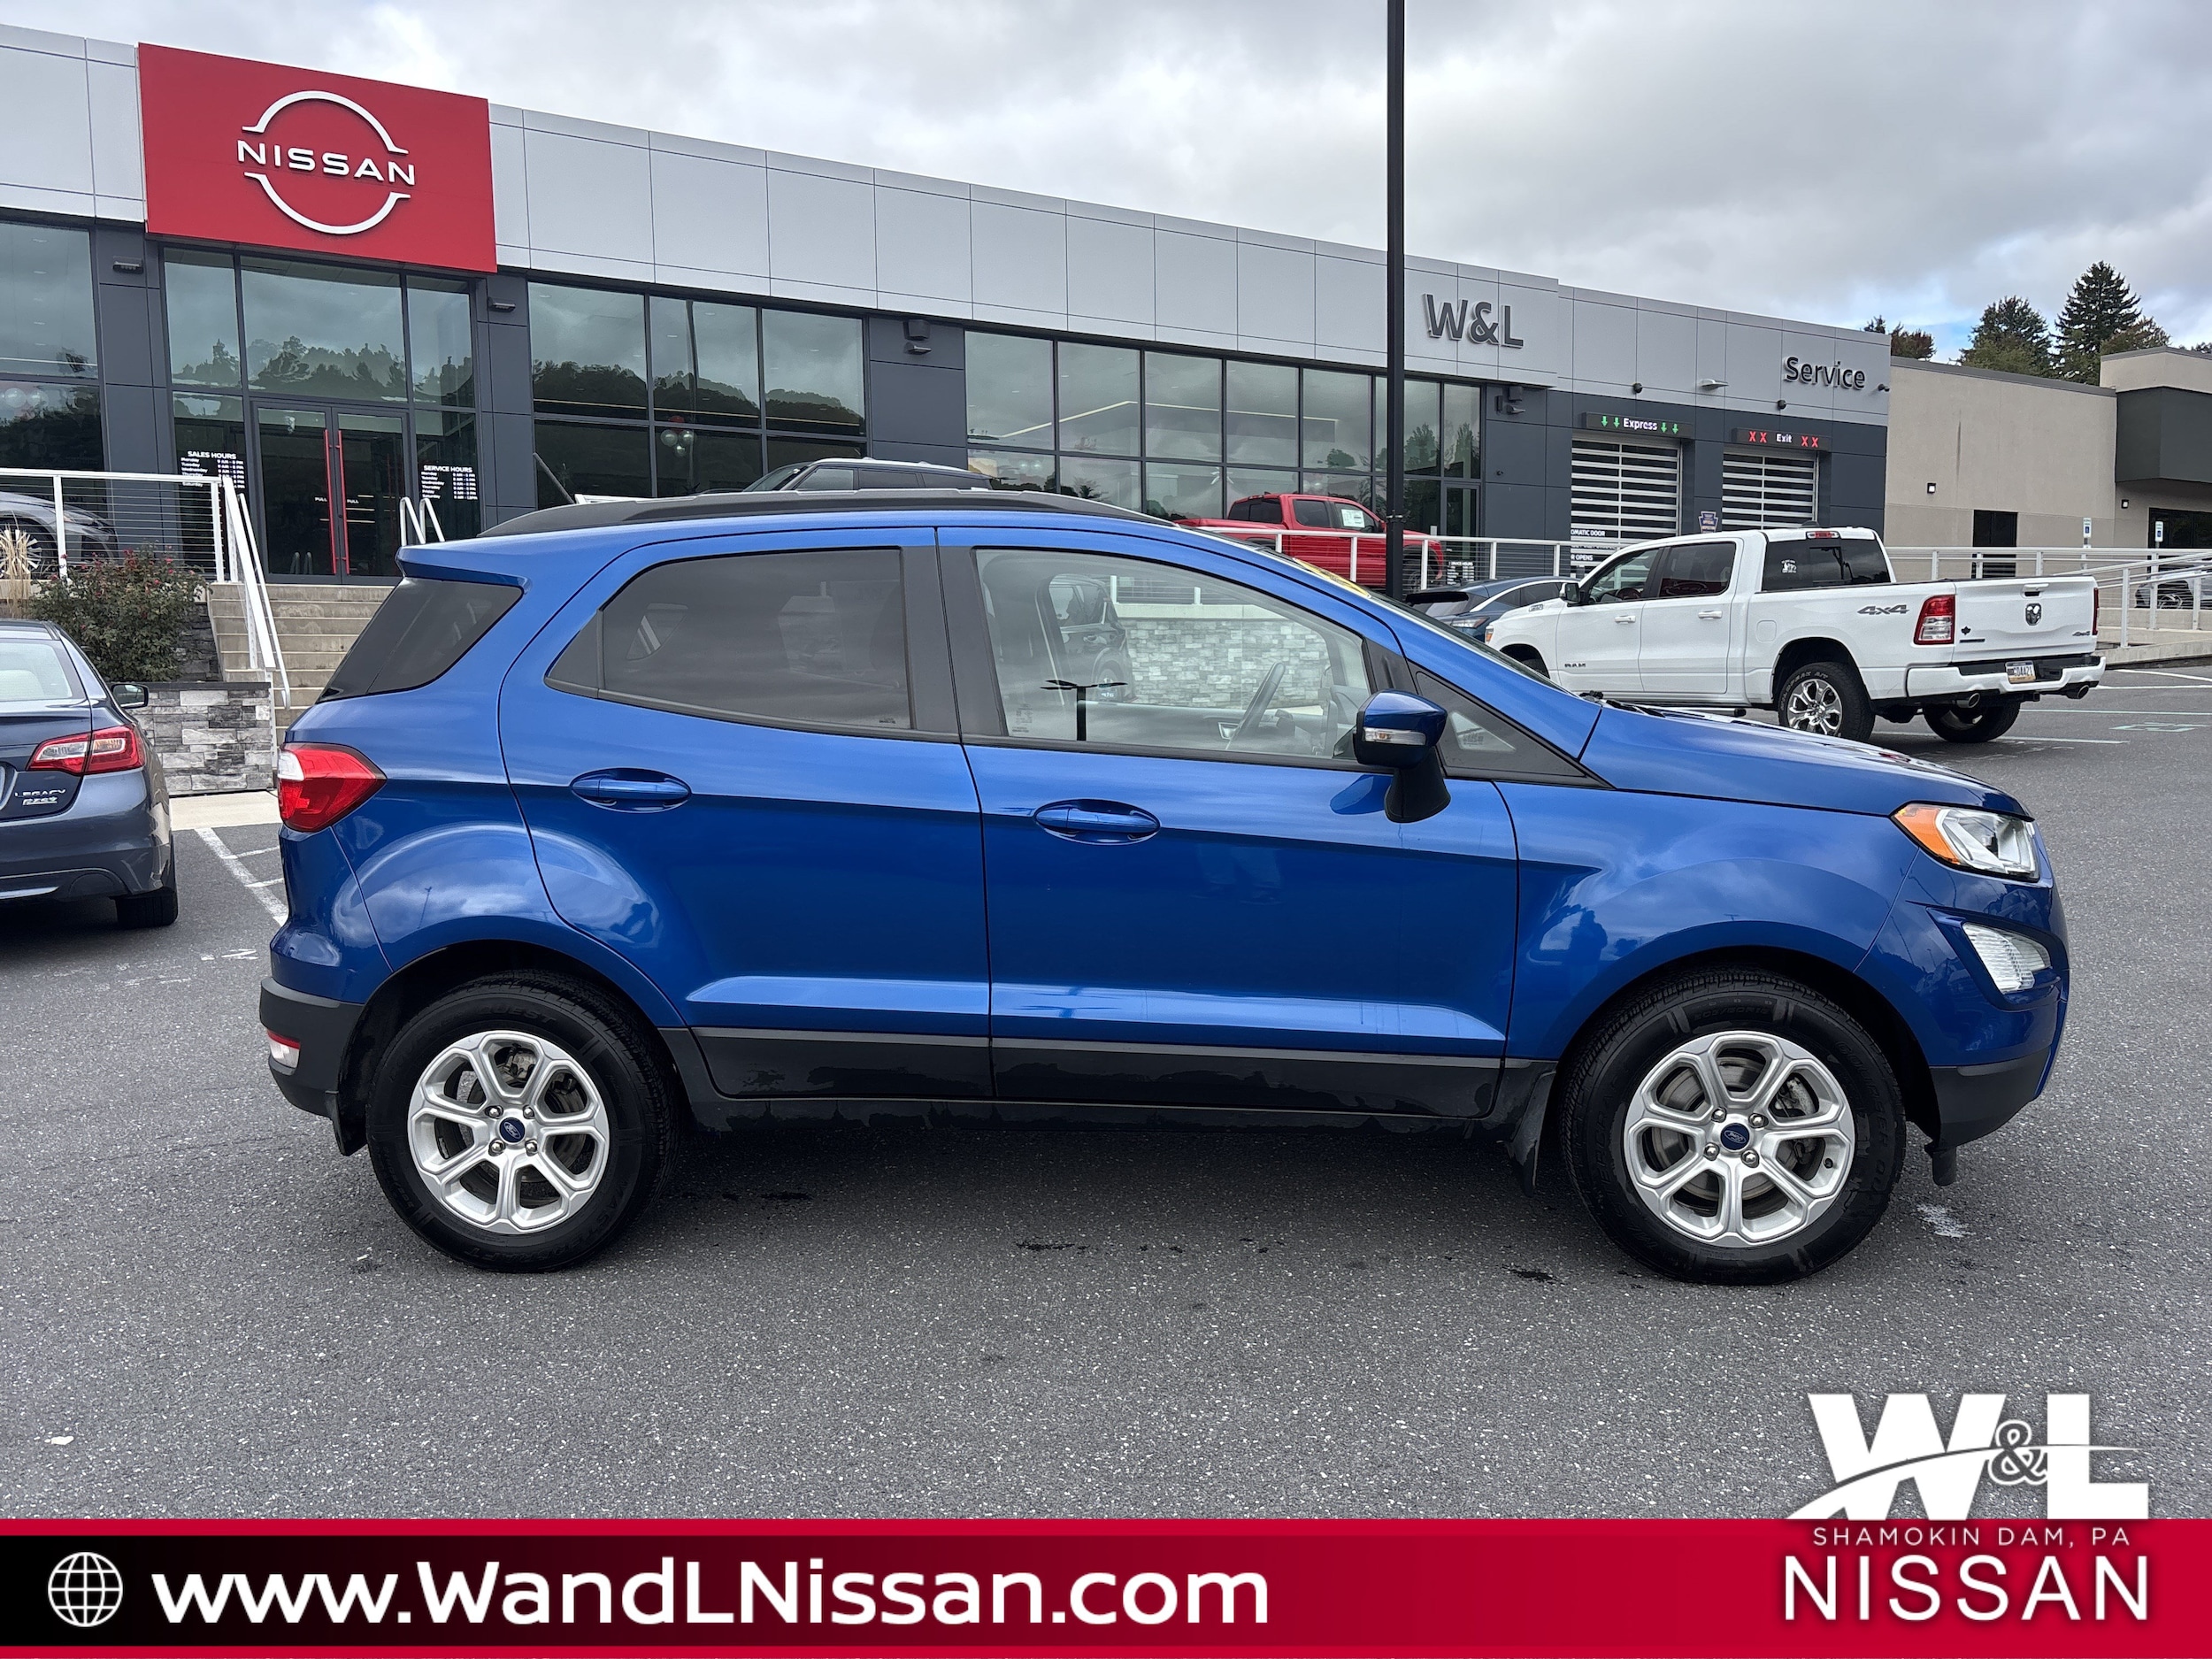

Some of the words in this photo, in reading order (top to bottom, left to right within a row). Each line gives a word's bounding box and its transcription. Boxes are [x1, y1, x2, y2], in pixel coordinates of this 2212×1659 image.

[237, 140, 416, 187] NISSAN
[1424, 293, 1525, 349] W&L
[1783, 357, 1865, 390] Service
[1623, 418, 1658, 431] Express
[1776, 433, 1793, 443] Exit
[1857, 604, 1910, 615] 4x4
